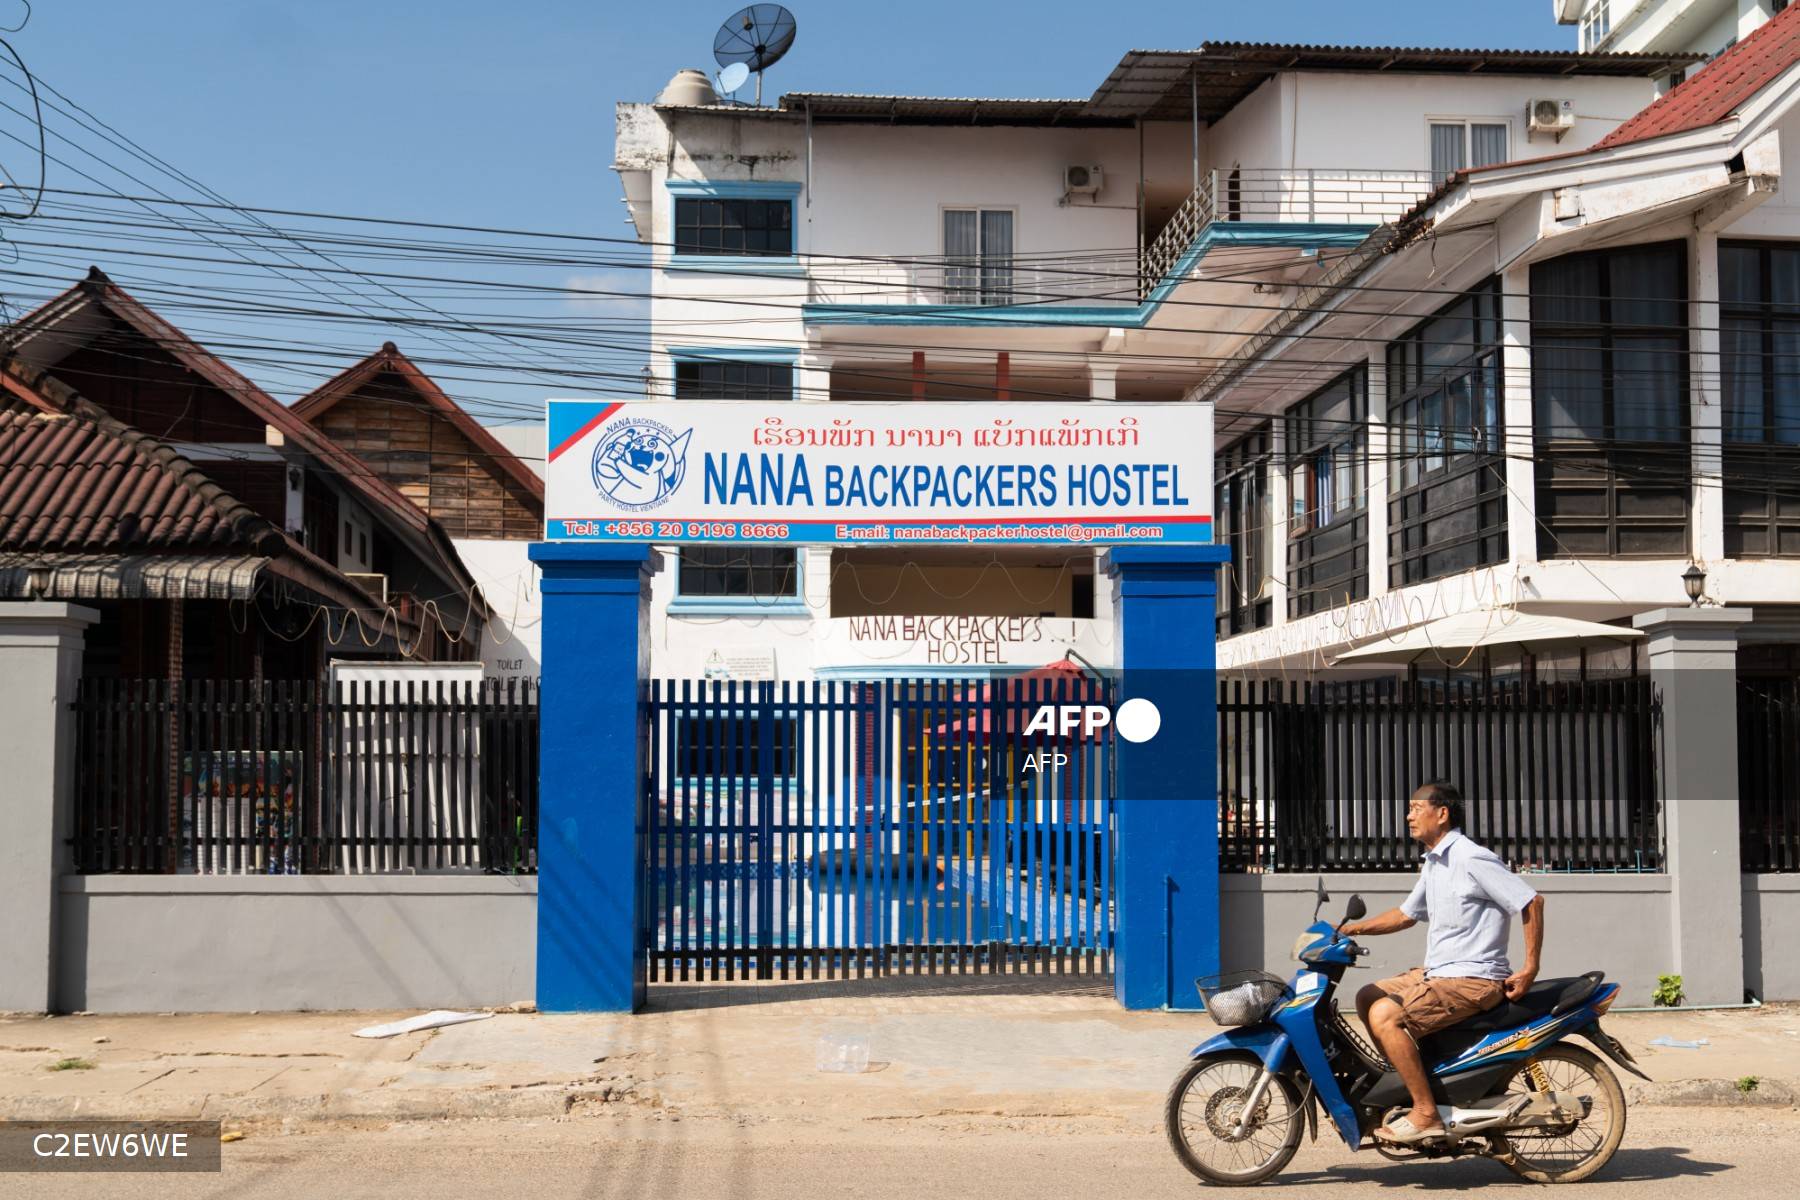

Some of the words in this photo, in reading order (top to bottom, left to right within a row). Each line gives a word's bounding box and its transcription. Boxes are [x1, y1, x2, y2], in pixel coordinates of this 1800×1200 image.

[606, 417, 631, 434] NANA
[885, 428, 963, 448] ນານາ
[703, 452, 814, 507] NANA
[824, 463, 1057, 508] BACKPACKERS
[1067, 463, 1190, 507] HOSTEL
[598, 491, 616, 508] PARTY
[616, 503, 639, 513] HOSTEL
[564, 522, 598, 536] Tel:
[605, 522, 653, 536] +856
[658, 523, 683, 536] 20
[688, 523, 735, 537] 9196
[741, 524, 788, 537] 8666
[836, 525, 889, 539] E-mail:
[894, 524, 1163, 541] nanabackpackerhostel@gmail.com
[849, 615, 897, 641] NANA
[928, 641, 1008, 664] HOSTEL
